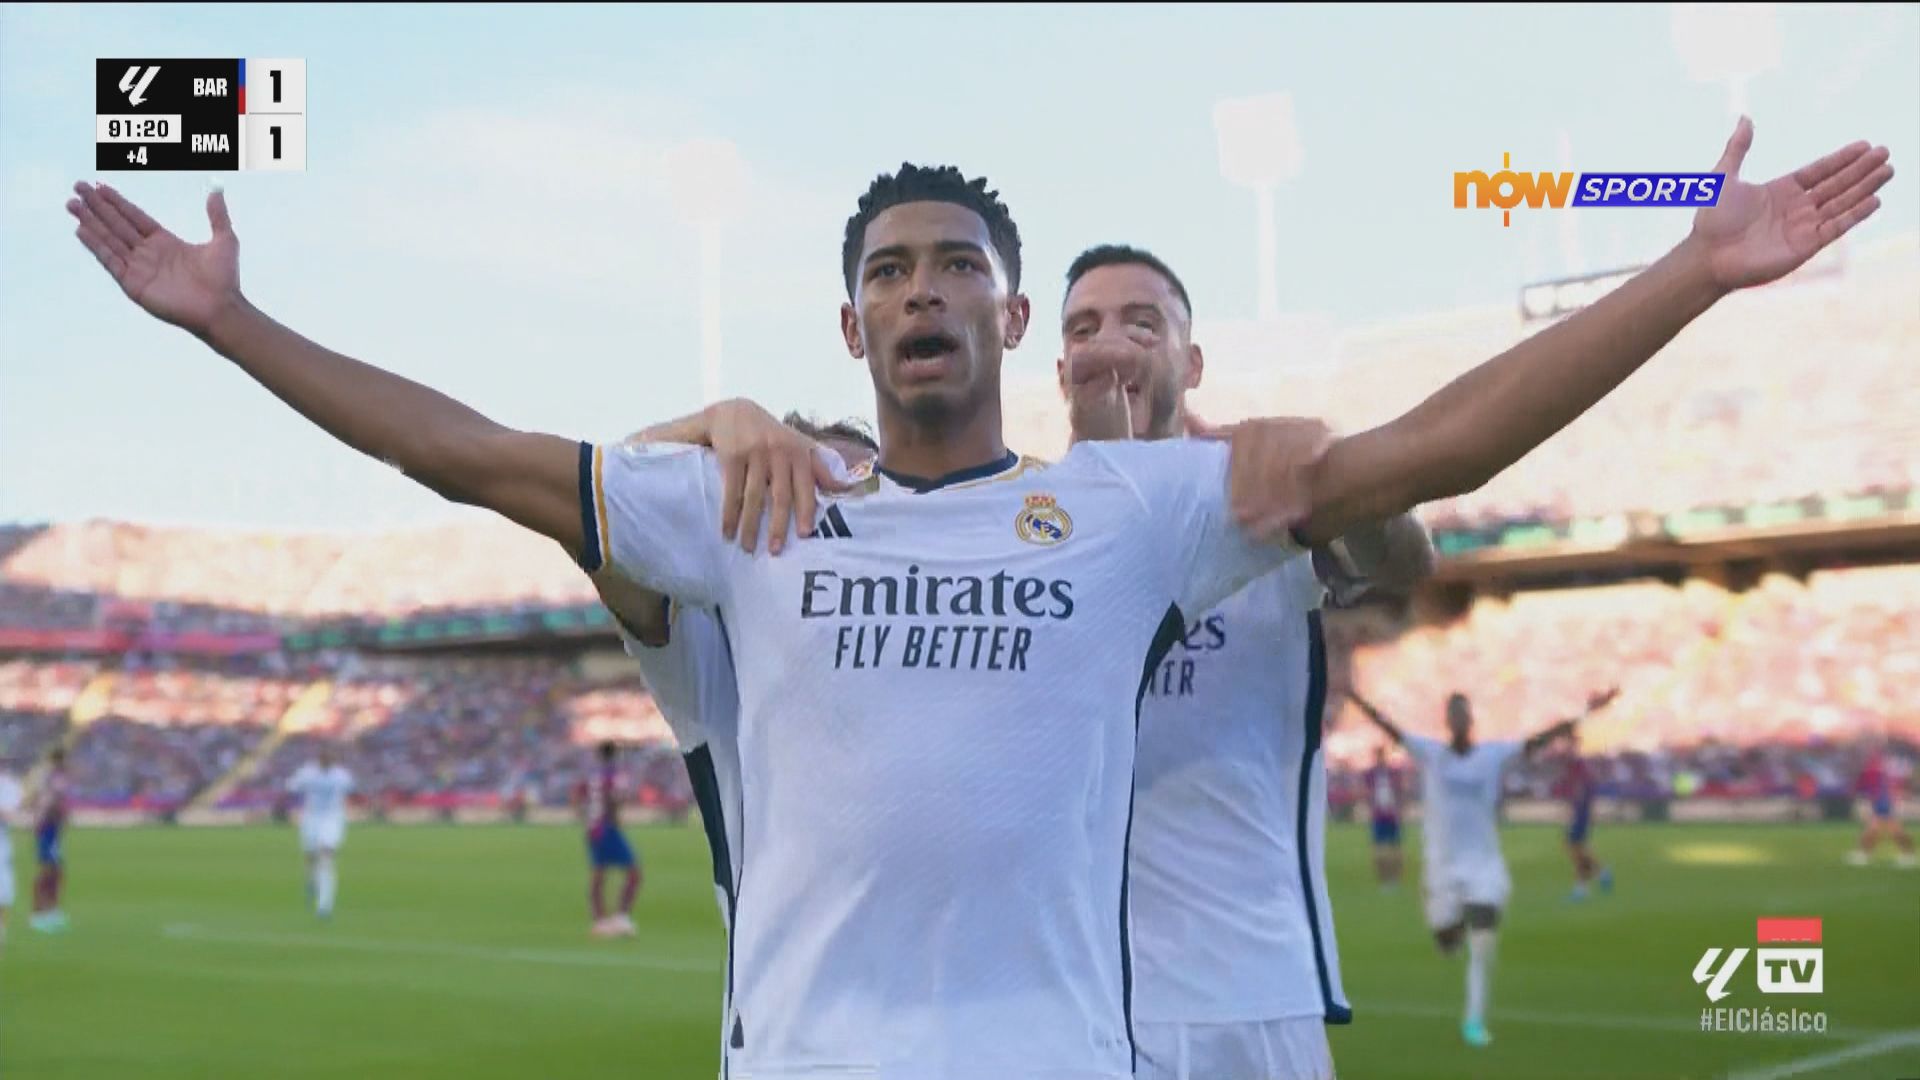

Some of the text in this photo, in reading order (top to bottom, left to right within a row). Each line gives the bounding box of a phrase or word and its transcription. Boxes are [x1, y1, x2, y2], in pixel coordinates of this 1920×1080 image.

[801, 564, 1074, 620] Emirates
[834, 625, 1032, 671] FLY BETTER
